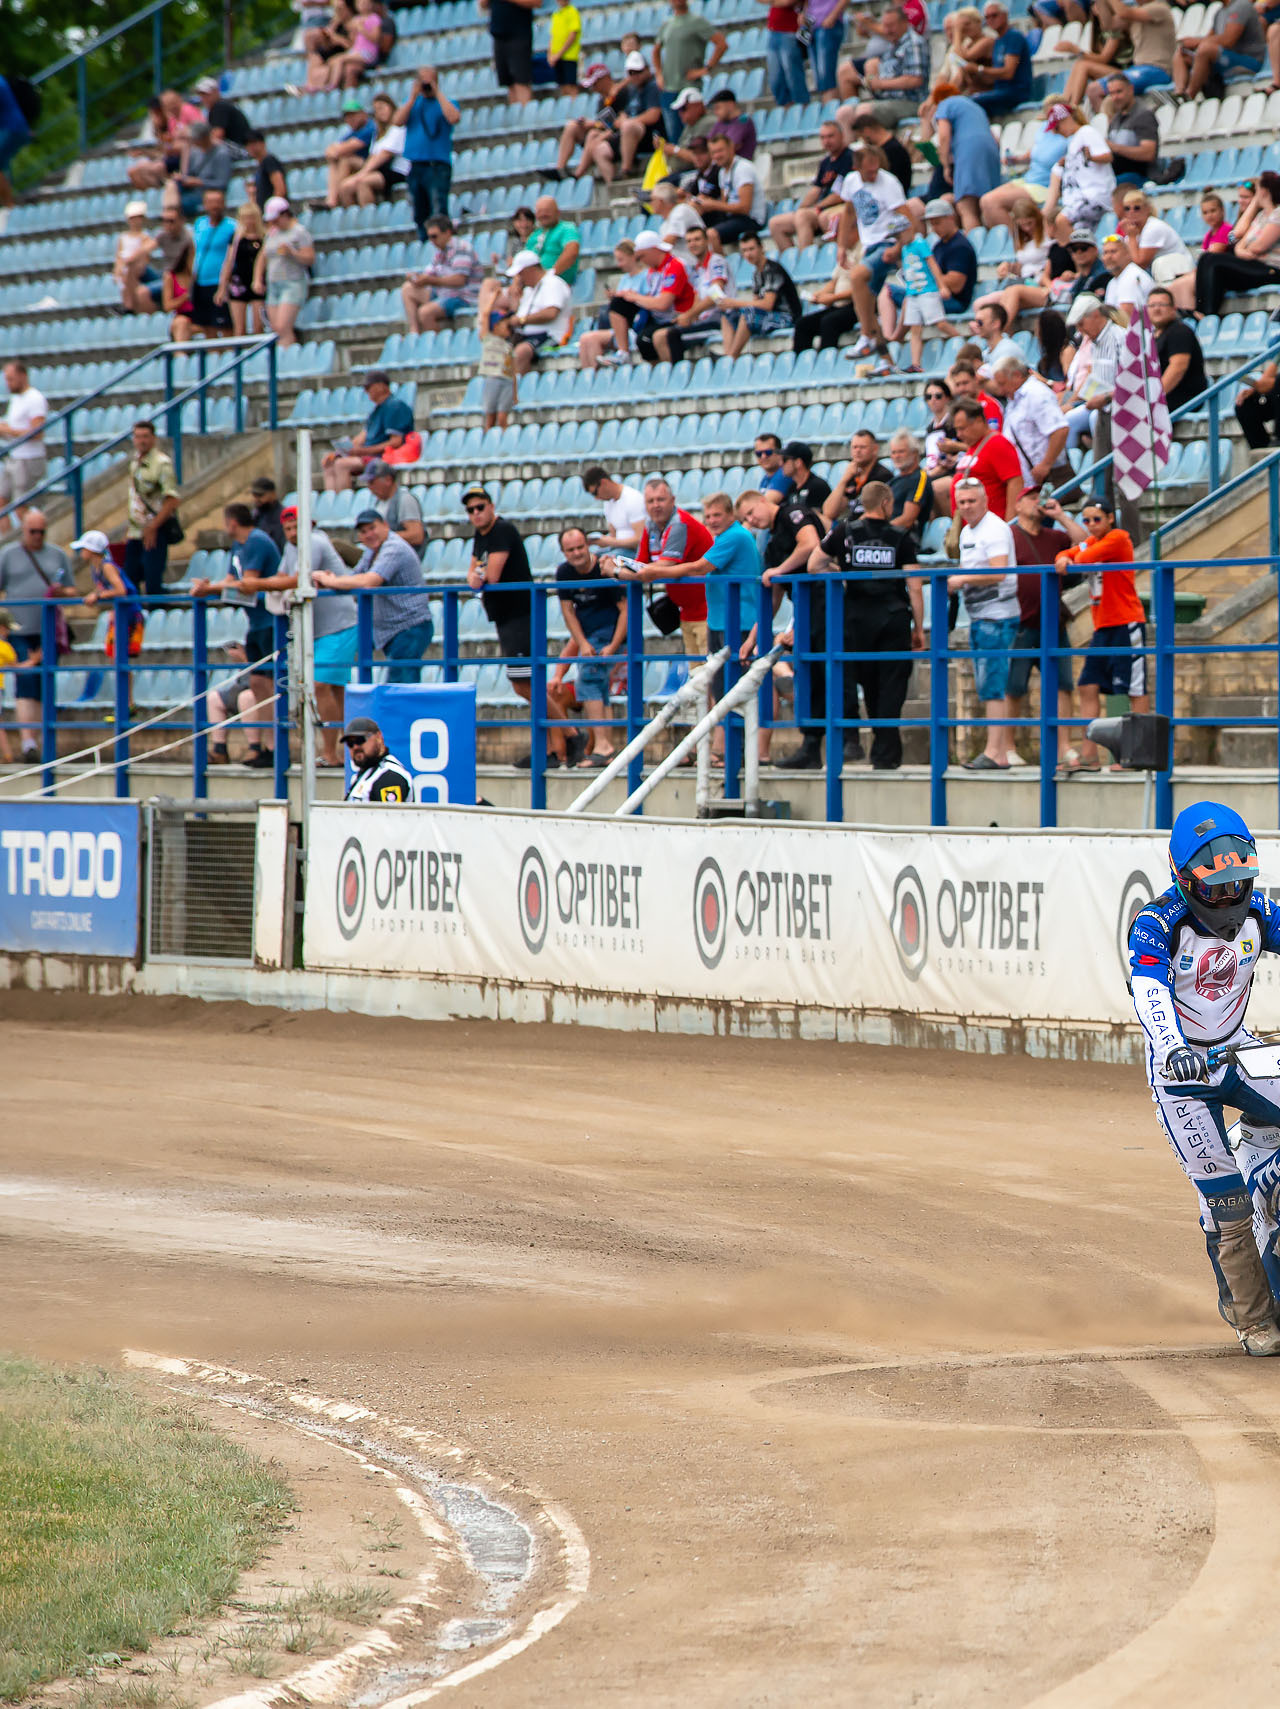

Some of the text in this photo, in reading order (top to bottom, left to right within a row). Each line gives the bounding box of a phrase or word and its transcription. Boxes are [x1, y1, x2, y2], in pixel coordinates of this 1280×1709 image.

[855, 549, 892, 564] GROM
[1, 830, 122, 899] TRODO
[374, 848, 462, 913] OPTIBET
[555, 859, 642, 930] OPTIBET
[735, 869, 832, 941] OPTIBET
[936, 879, 1045, 951] OPTIBET
[1147, 988, 1179, 1049] SAGARI
[1172, 1099, 1217, 1175] SAGARI
[1195, 1114, 1215, 1150] SPORTS
[1207, 1194, 1250, 1208] SAGAR
